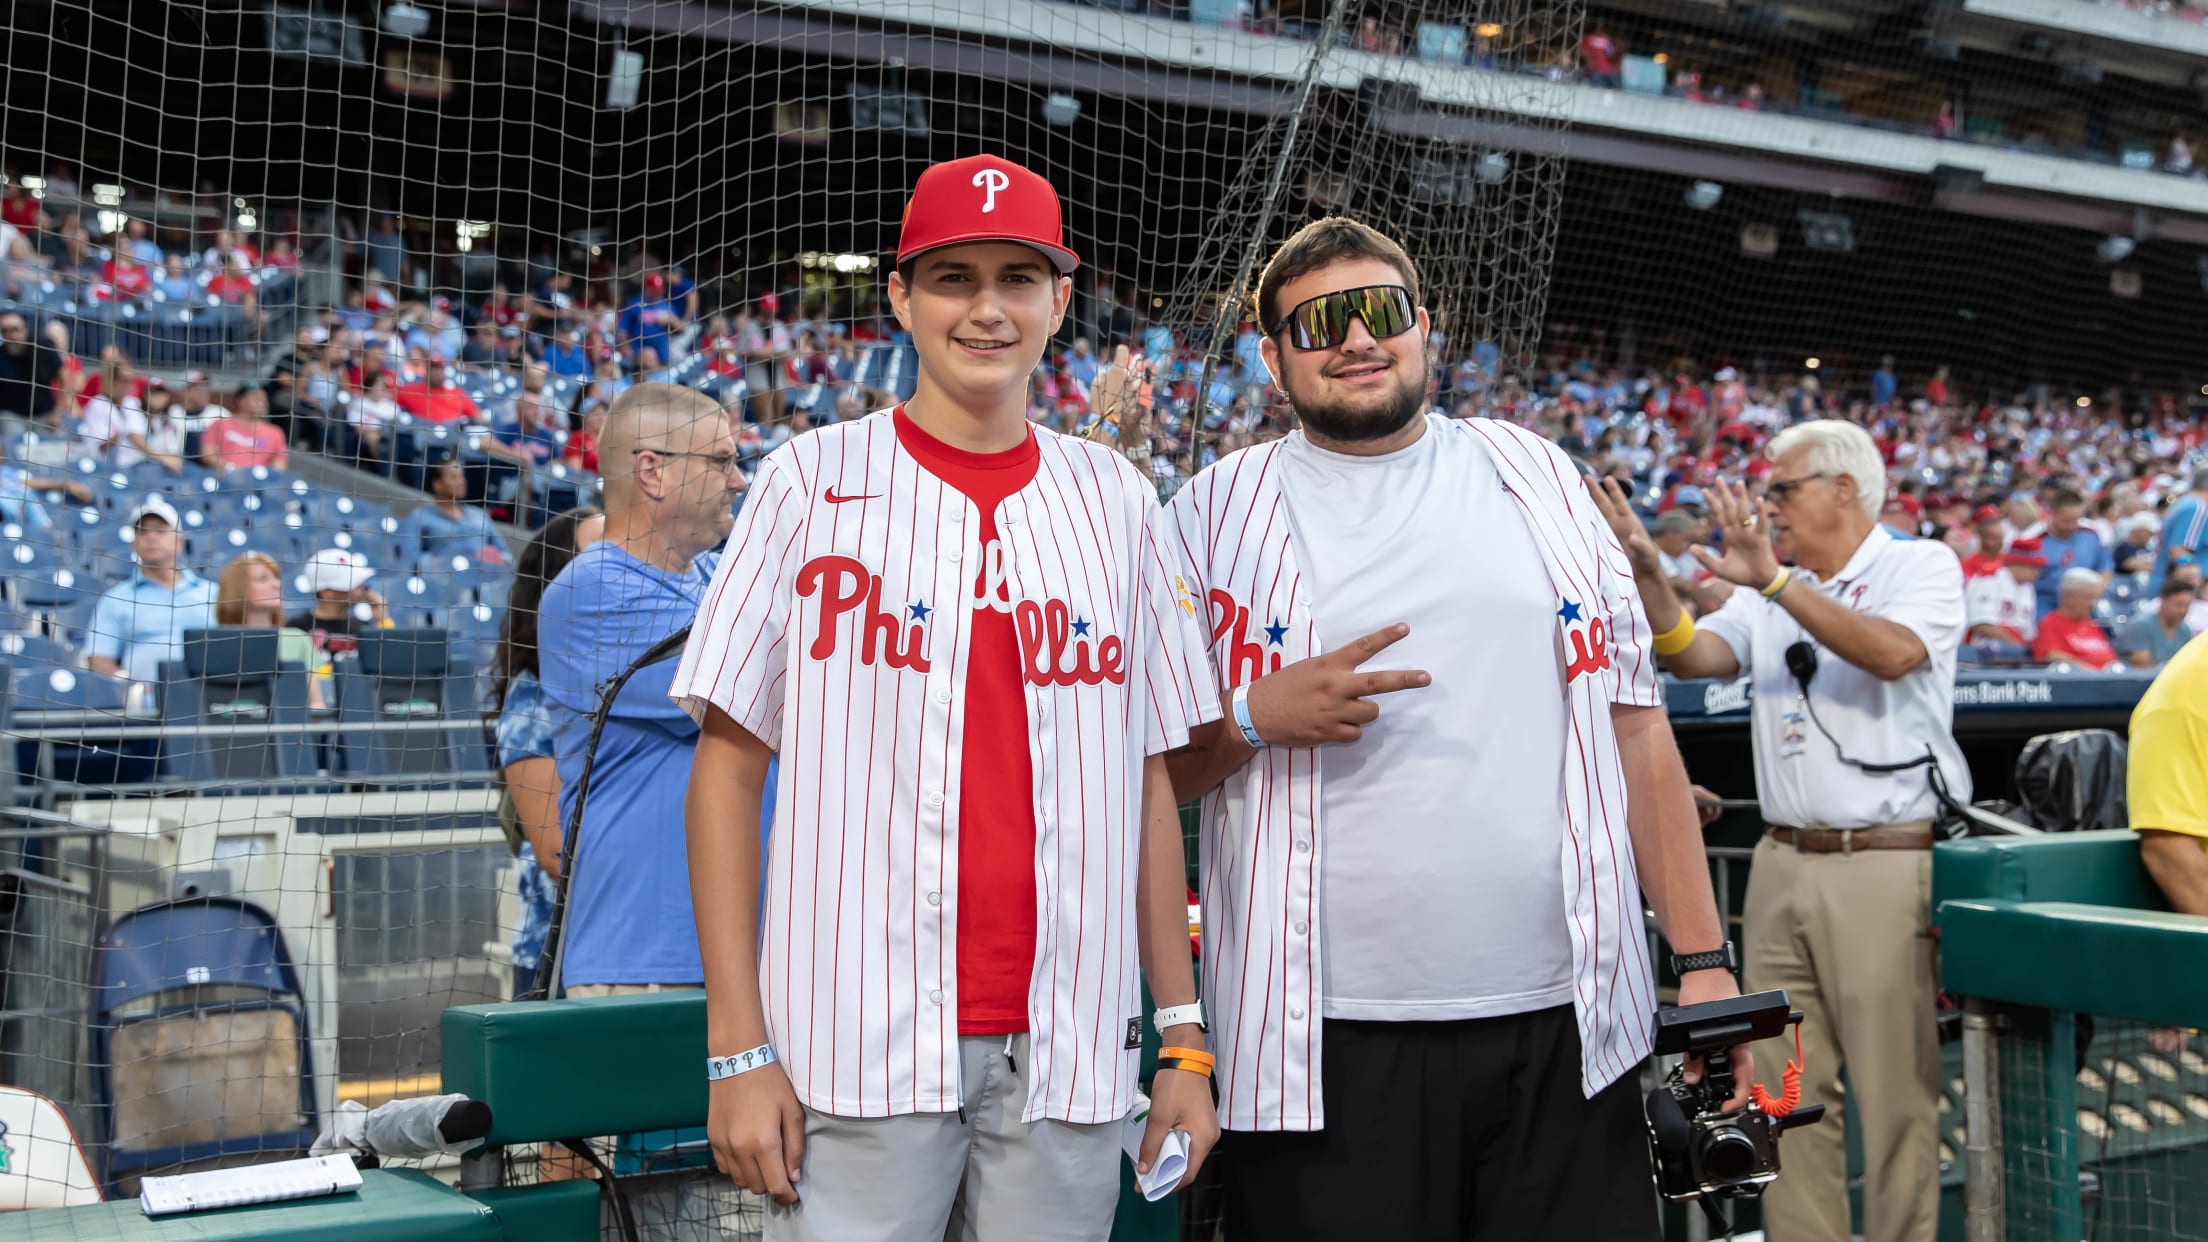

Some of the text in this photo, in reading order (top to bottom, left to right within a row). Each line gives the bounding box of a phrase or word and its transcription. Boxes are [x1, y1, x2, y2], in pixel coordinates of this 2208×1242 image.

[972, 168, 1010, 213] P
[1979, 680, 2016, 703] Bank
[2017, 679, 2052, 703] Park
[726, 1057, 737, 1073] P
[742, 1052, 754, 1068] P
[758, 1046, 768, 1063] P
